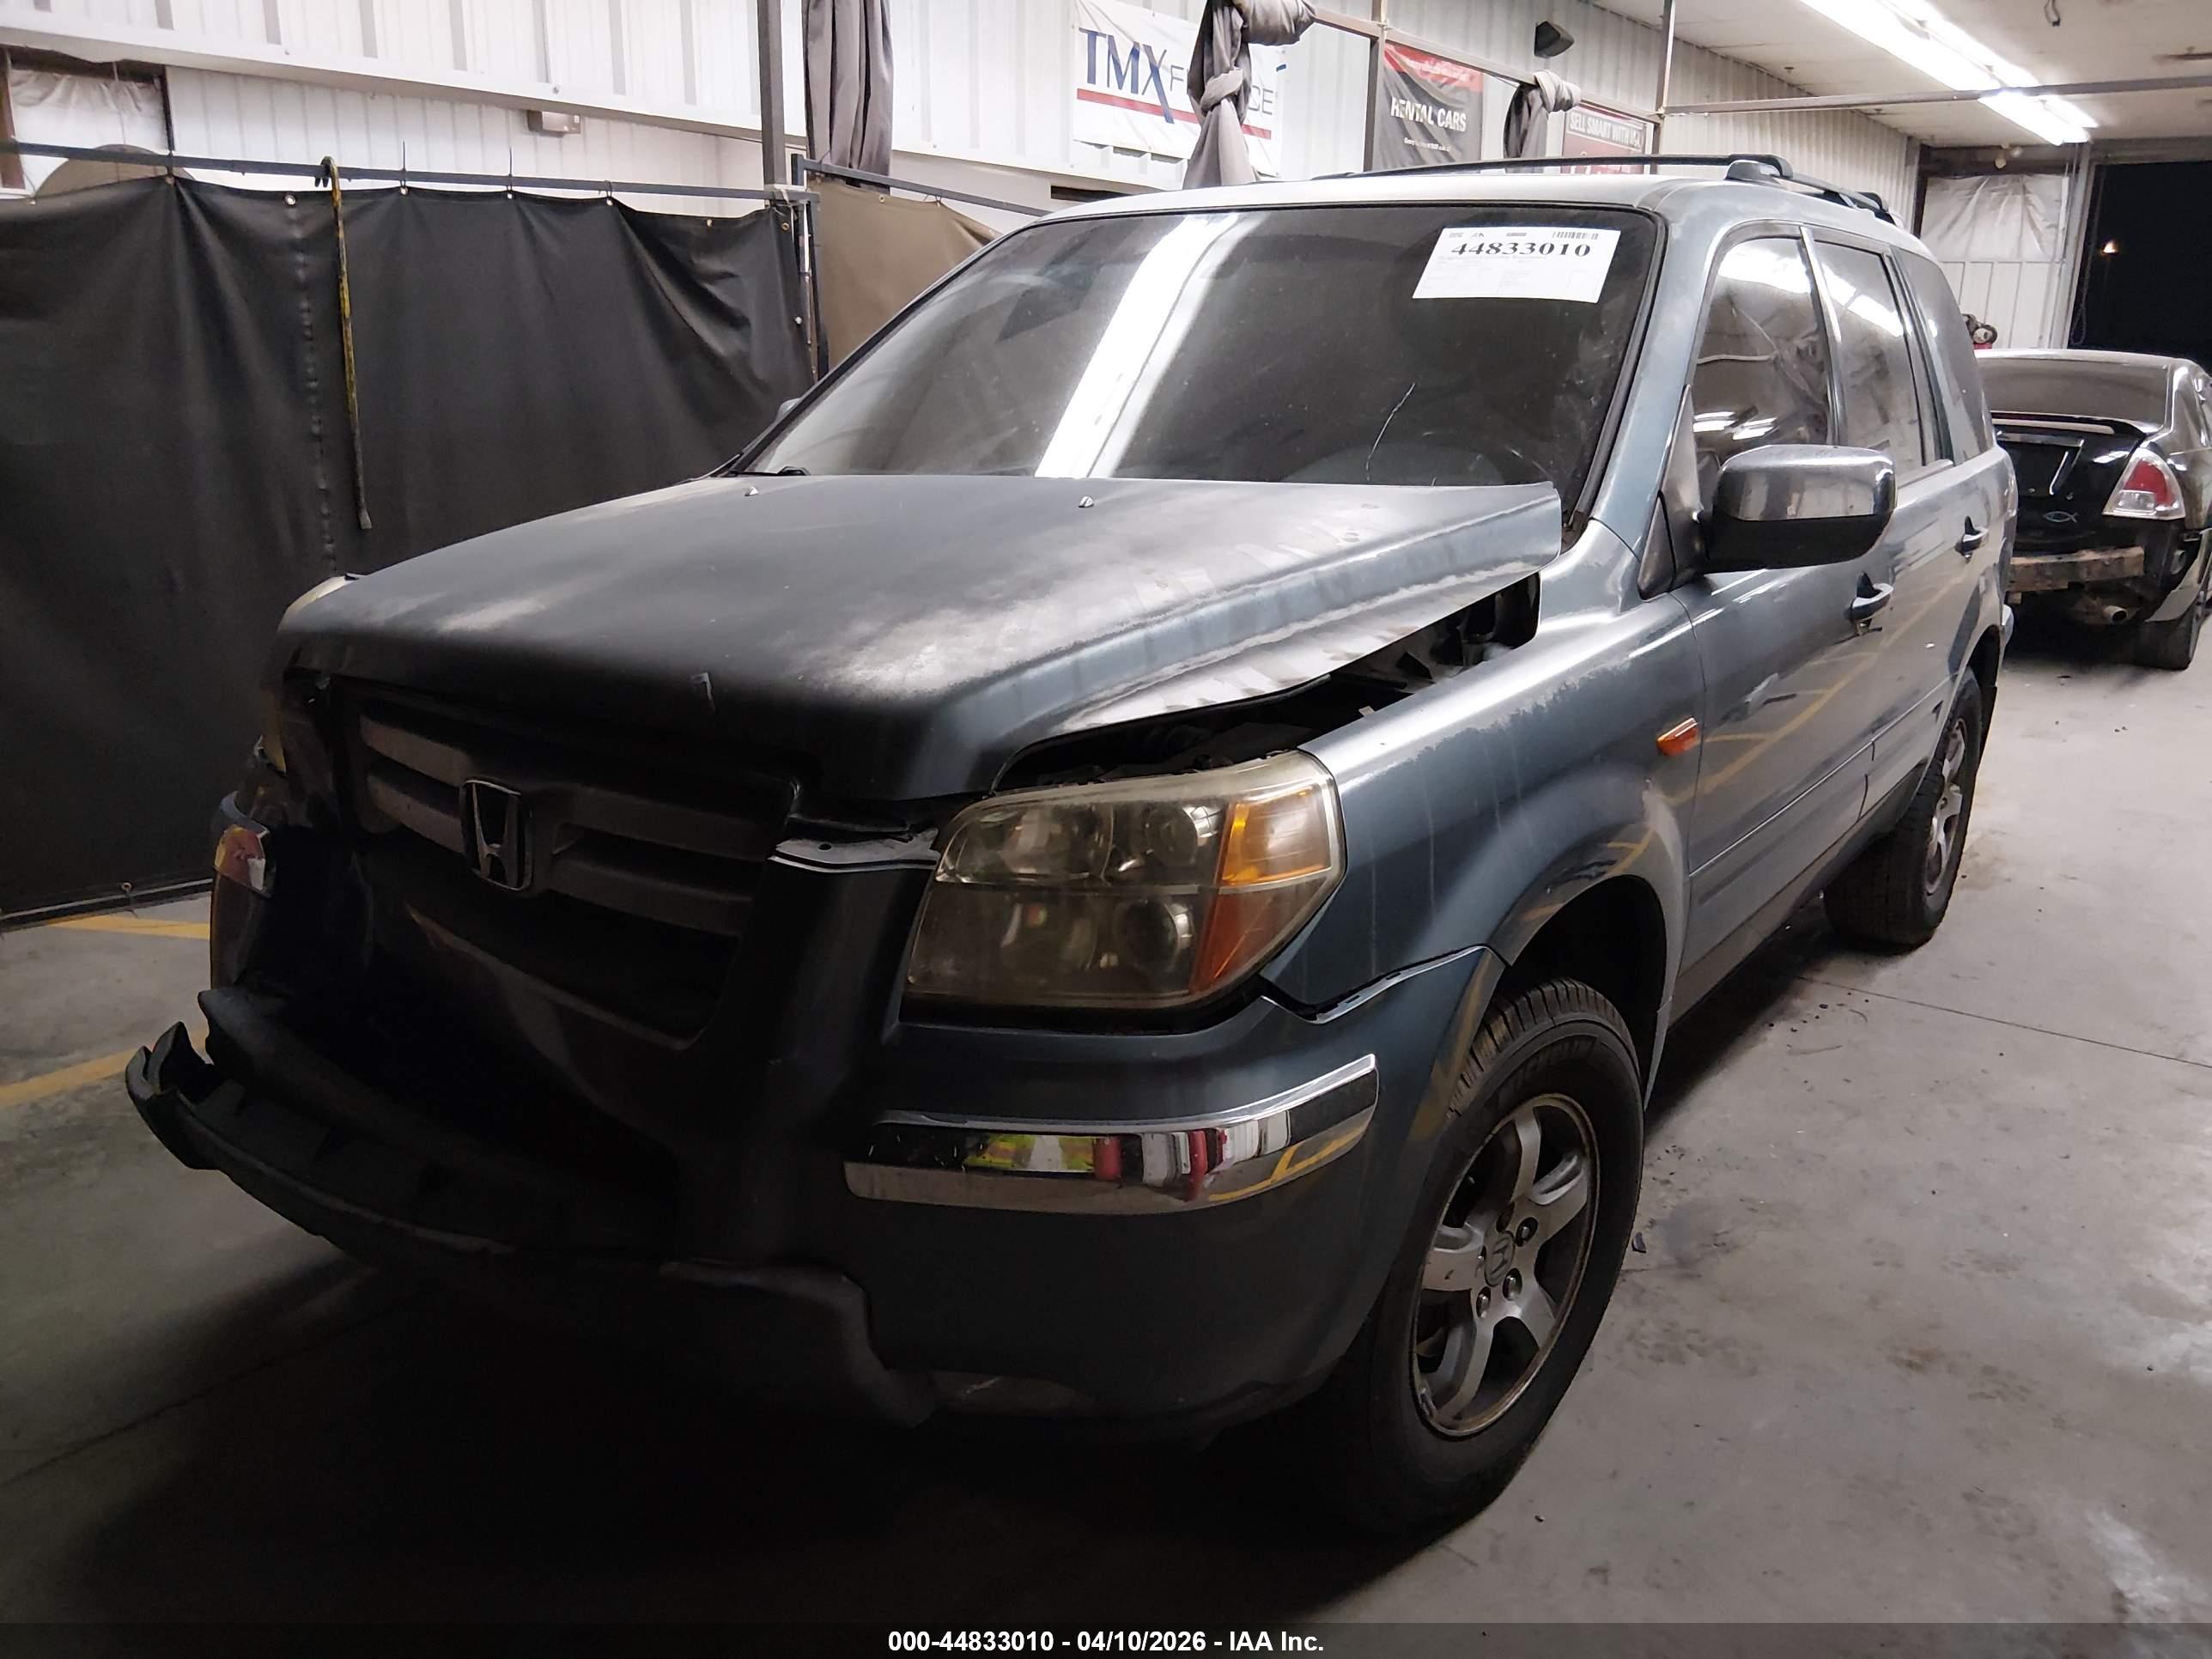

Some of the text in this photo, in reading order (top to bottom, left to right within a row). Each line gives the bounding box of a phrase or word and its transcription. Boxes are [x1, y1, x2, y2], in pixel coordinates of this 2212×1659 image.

[1079, 27, 1175, 125] TMX
[1390, 96, 1467, 132] RENTAL CARS
[1450, 242, 1591, 257] 44833010
